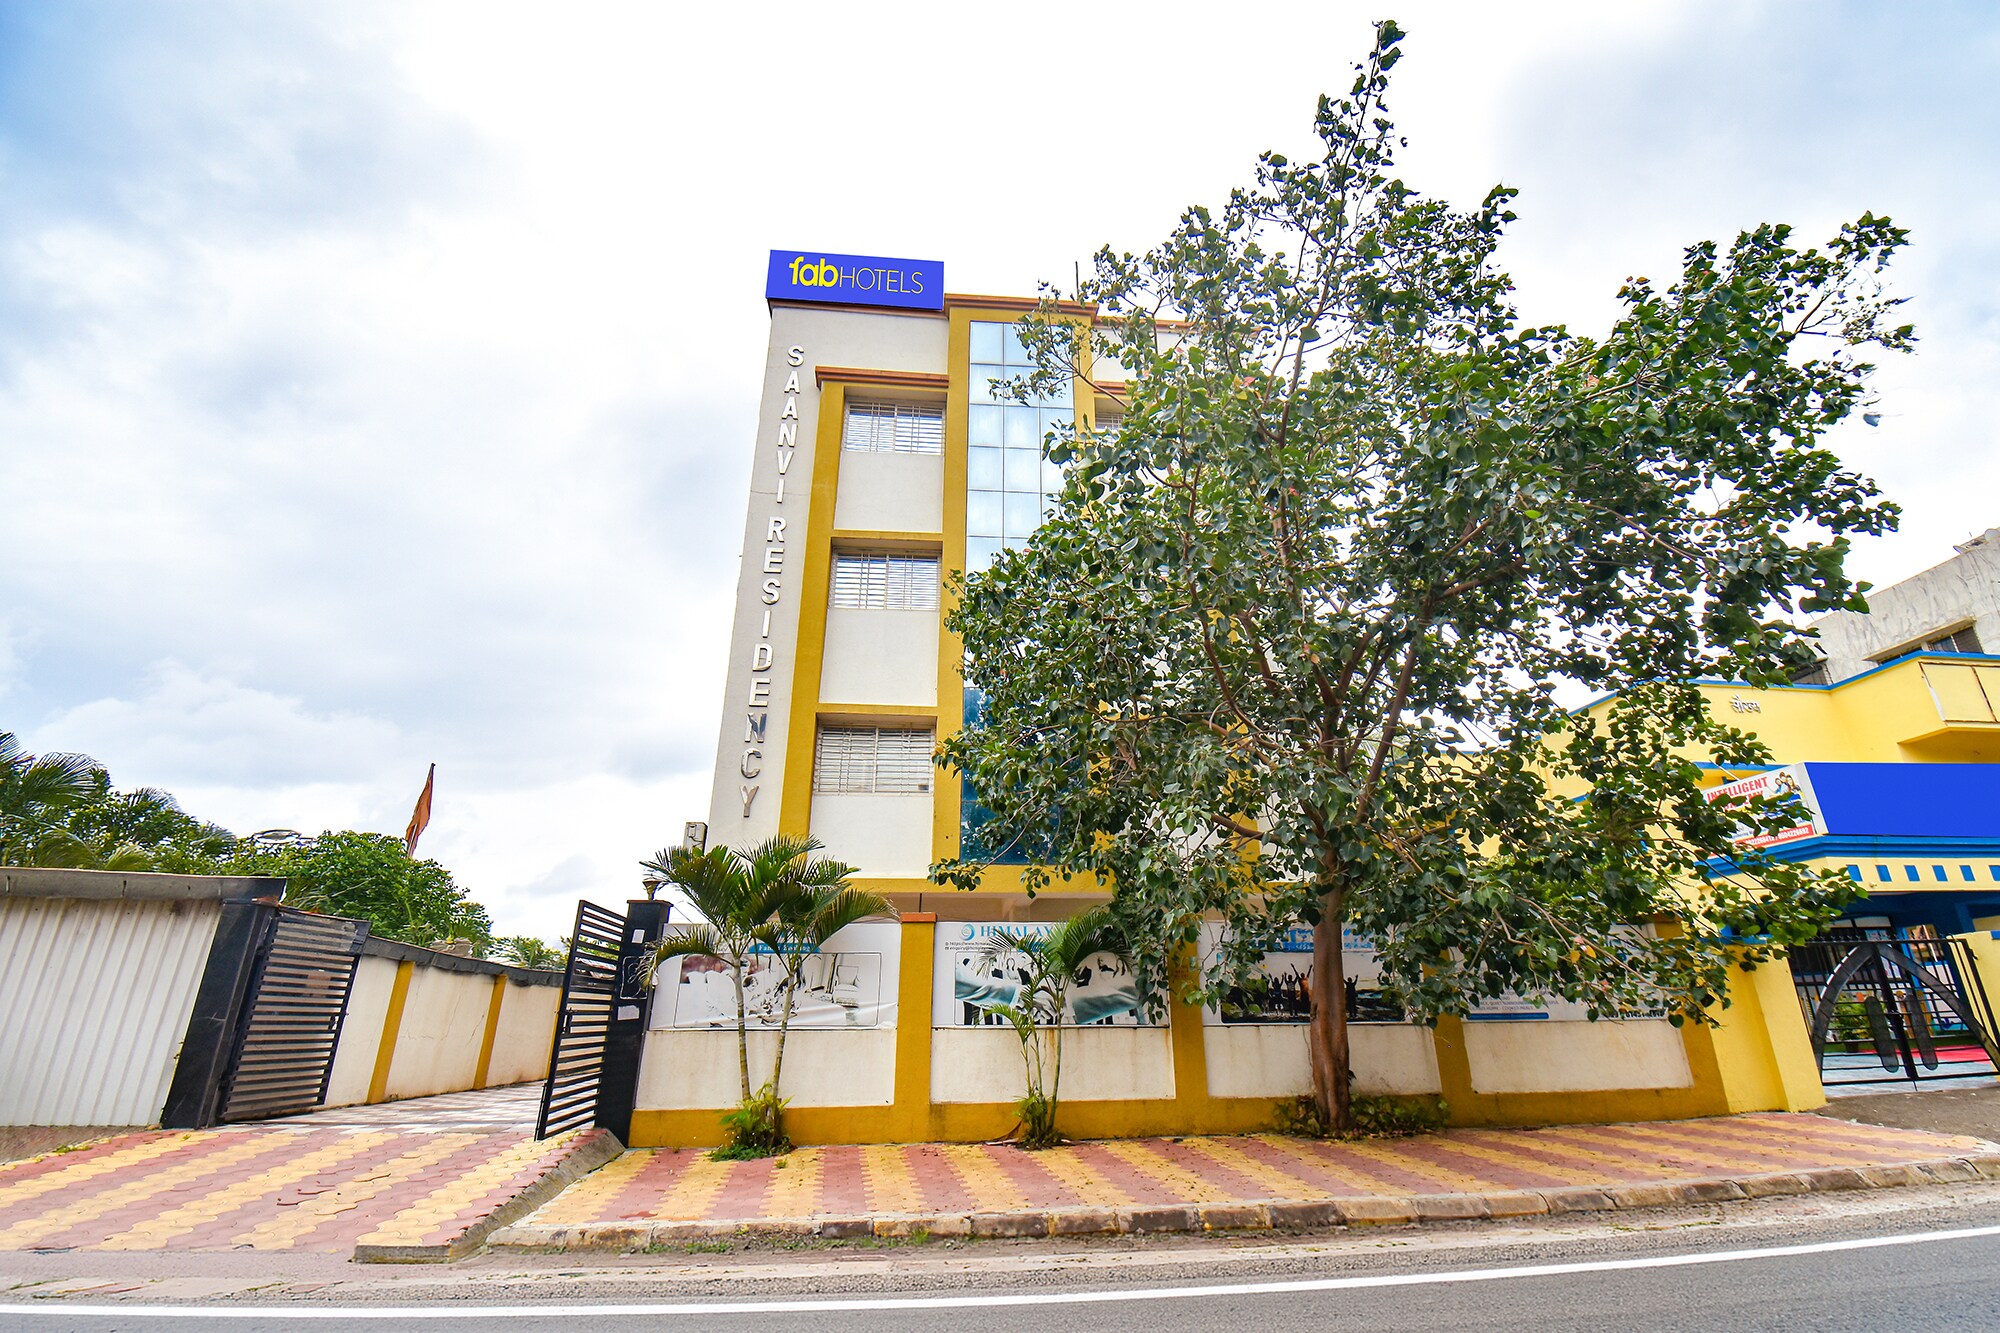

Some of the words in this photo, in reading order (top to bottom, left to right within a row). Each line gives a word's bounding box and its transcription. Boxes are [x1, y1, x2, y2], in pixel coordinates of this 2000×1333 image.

[788, 256, 924, 295] fabHOTELS
[776, 344, 805, 504] SAANVI
[739, 516, 788, 818] RESIDENCY
